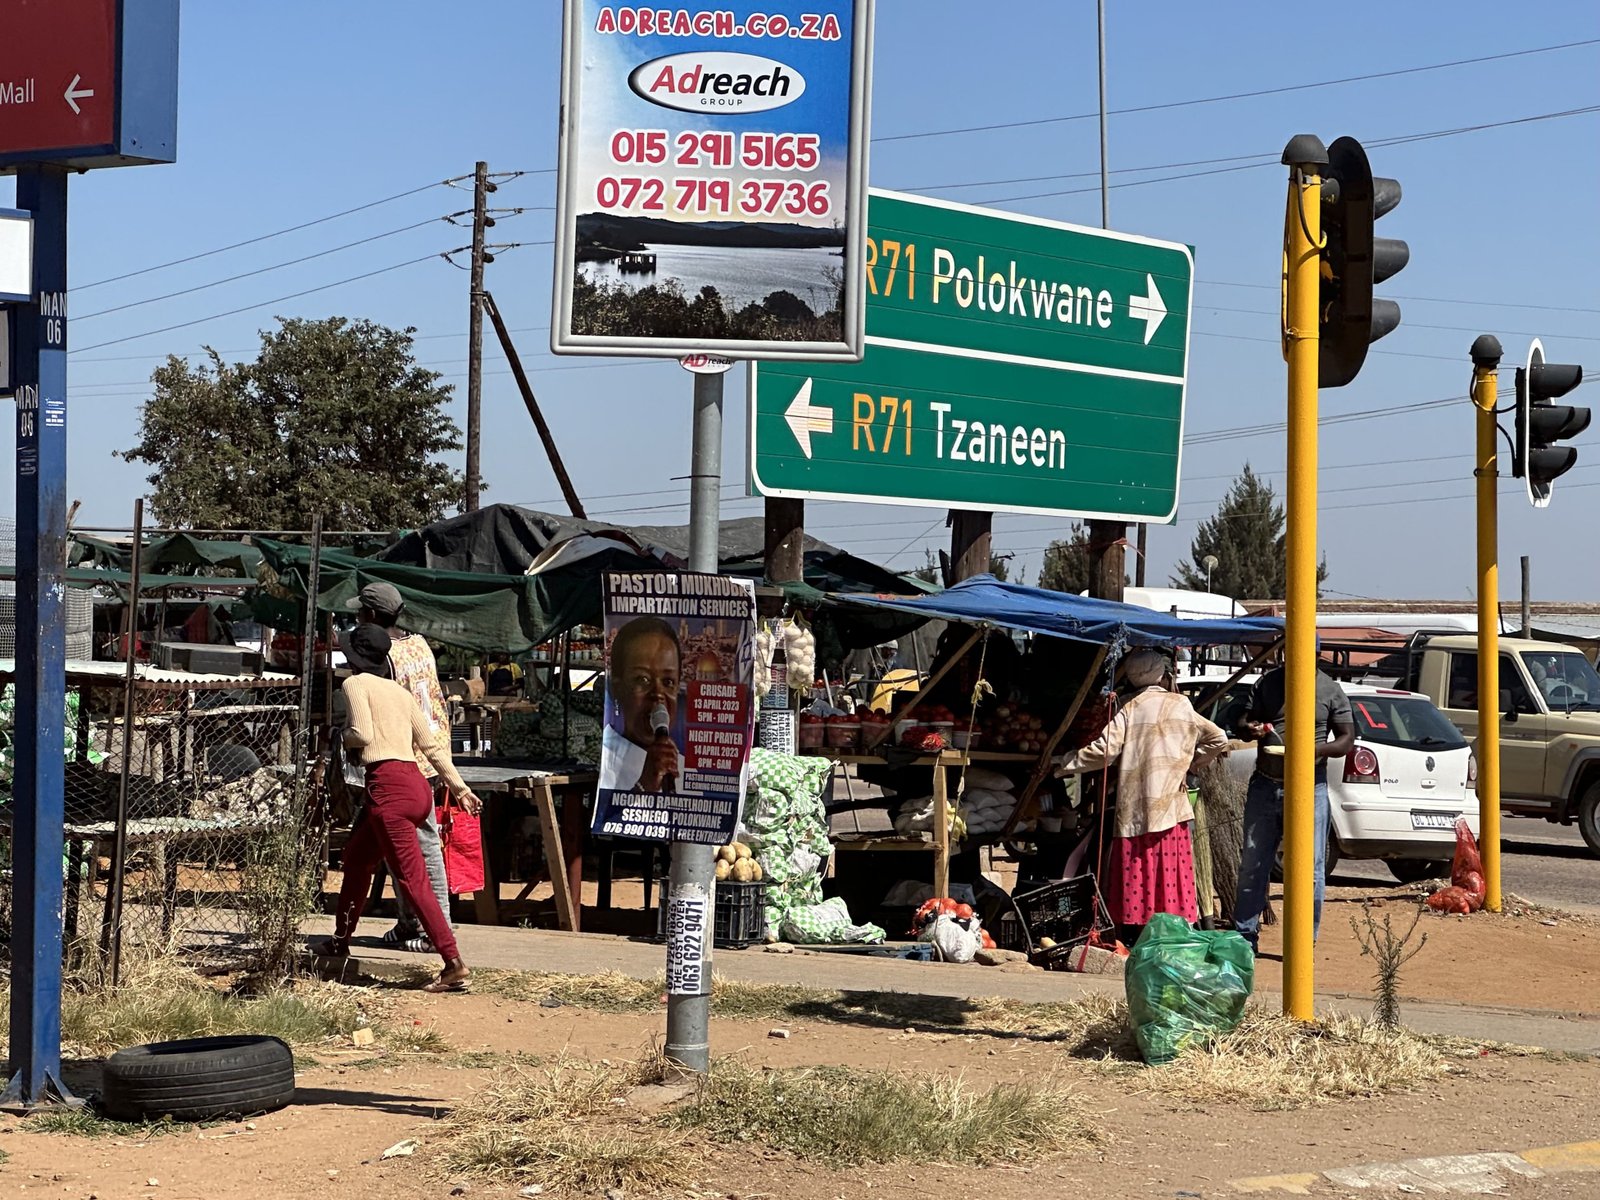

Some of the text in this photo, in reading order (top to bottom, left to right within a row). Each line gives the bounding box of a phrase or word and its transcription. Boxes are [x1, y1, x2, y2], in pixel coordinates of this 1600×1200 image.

[597, 8, 841, 39] ADREACH.CO.ZA
[0, 78, 34, 105] Mall
[649, 64, 790, 97] Adreach
[700, 97, 743, 106] GROUP
[612, 131, 817, 168] 015 291 5165
[597, 177, 829, 215] 072 719 3736
[866, 237, 1113, 328] R71 Polokwane
[40, 291, 67, 317] MAN
[47, 318, 61, 344] 06
[21, 411, 33, 437] 06
[852, 392, 1066, 470] R71 Tzaneen
[609, 573, 679, 594] PASTOR
[611, 596, 749, 617] IMPARTATION SERVICES
[700, 684, 737, 698] CRUSADE
[694, 699, 740, 711] 13 APRIL 2023
[697, 711, 713, 722] 5PM
[717, 713, 735, 724] 10PM
[689, 730, 743, 745] NIGHT PRAYER
[694, 744, 739, 758] 14 APRIL 2023
[611, 792, 655, 808] NGOAKO
[713, 801, 732, 815] HALL
[602, 821, 623, 834] 076
[623, 823, 645, 836] 990
[645, 825, 670, 839] 0391
[677, 828, 695, 841] FREE
[621, 808, 722, 829] SESHEGO, POLOKWANE
[674, 900, 686, 990] THE LOST LOVER
[682, 901, 703, 991] 063 622 9471
